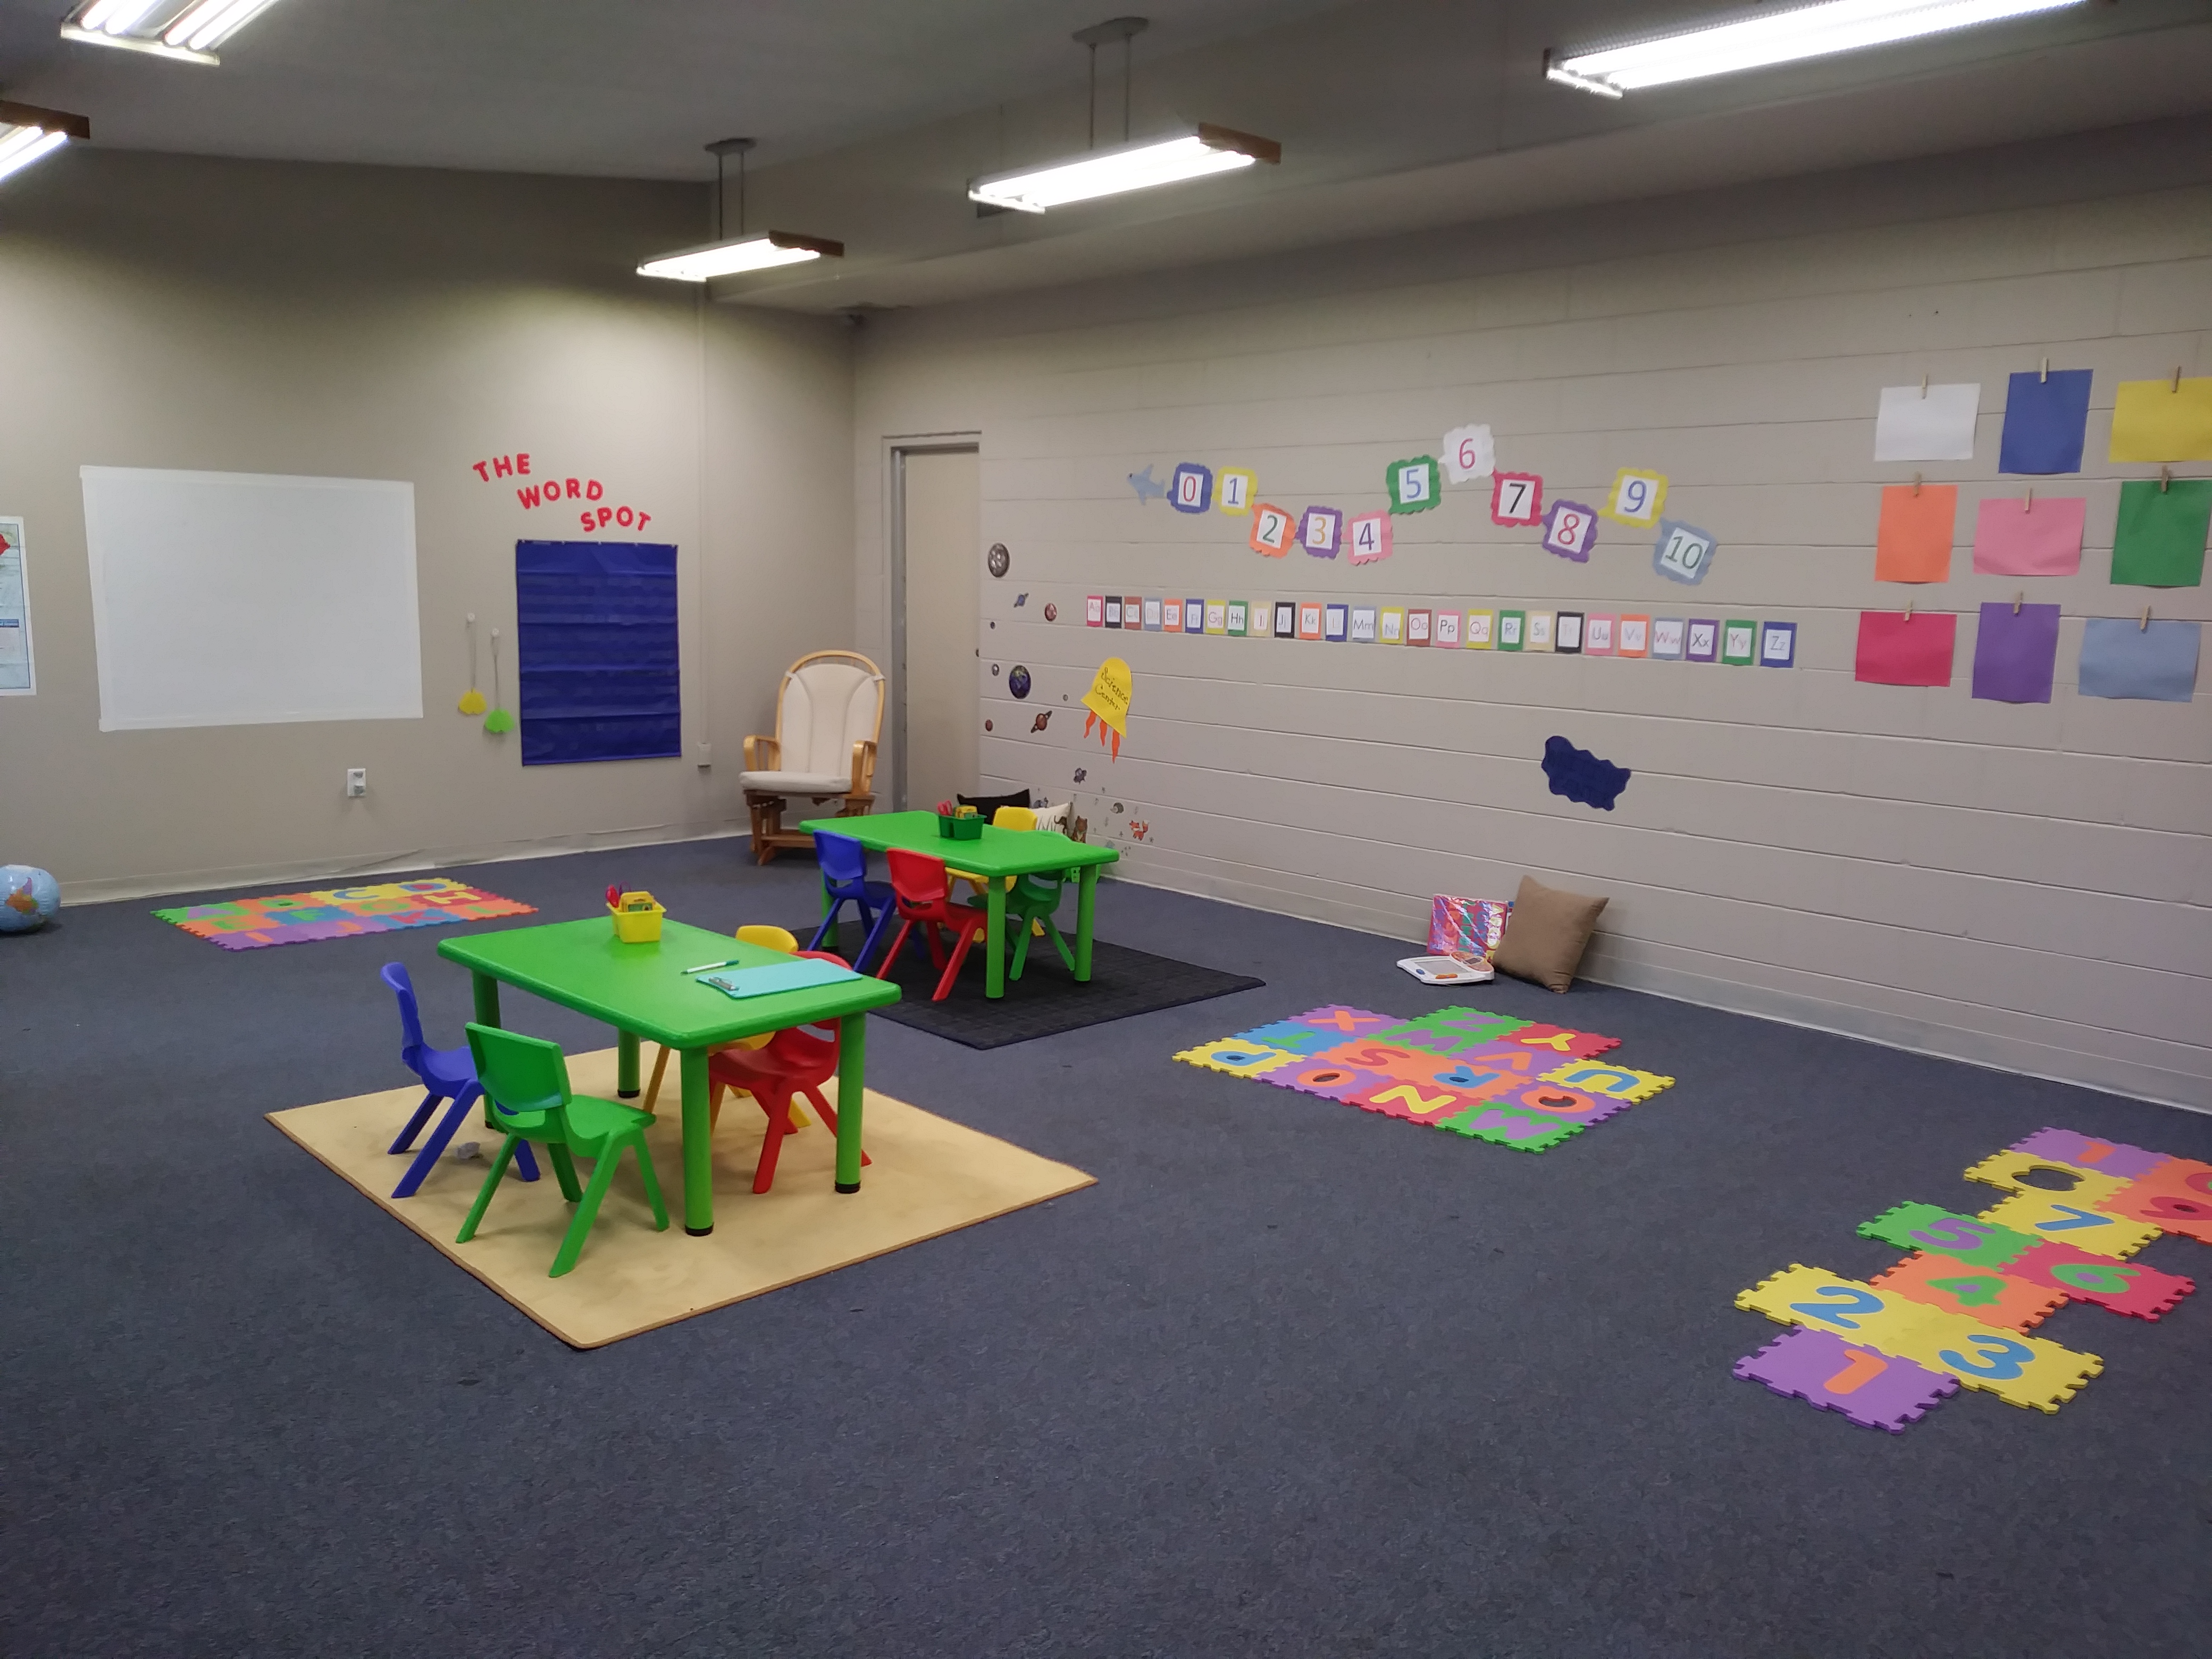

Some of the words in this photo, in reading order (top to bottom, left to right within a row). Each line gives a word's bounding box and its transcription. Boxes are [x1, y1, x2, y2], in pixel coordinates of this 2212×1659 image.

[473, 453, 531, 482] THE
[517, 477, 603, 509] WORD
[1183, 476, 1196, 502] 0
[1228, 477, 1239, 505] 1
[1262, 515, 1278, 544] 2
[1312, 517, 1327, 544] 3
[1359, 523, 1375, 551] 4
[1405, 468, 1422, 499] 5
[1458, 438, 1476, 468] 6
[1509, 482, 1527, 514] 7
[1557, 514, 1580, 546] 8
[1624, 480, 1647, 513] 9
[1665, 535, 1703, 569] 10
[581, 506, 651, 532] SPOT
[1230, 612, 1244, 624] Hh
[1305, 613, 1316, 625] Kk
[1354, 618, 1374, 631] Mm
[1411, 617, 1428, 630] Oo
[1440, 619, 1454, 634] Pp
[1692, 633, 1710, 647] Xx
[1730, 633, 1747, 650] Yy
[1770, 635, 1786, 650] Zz
[1095, 684, 1120, 710] Center
[1101, 667, 1128, 705] Science
[333, 889, 381, 900] C
[398, 883, 447, 892] D
[424, 891, 482, 904] H
[389, 911, 446, 924] K
[1308, 1010, 1381, 1031] X
[1261, 1031, 1316, 1048] T
[1520, 1033, 1576, 1051] Y
[1345, 1048, 1411, 1066] S
[1297, 1068, 1356, 1087] O
[1434, 1066, 1500, 1088] R
[1564, 1069, 1640, 1093] U
[2076, 1141, 2116, 1163] 1
[2035, 1204, 2114, 1231] 7
[2140, 1196, 2212, 1220] 9
[1910, 1218, 1996, 1250] 5
[2051, 1264, 2141, 1294] 6
[1925, 1275, 2008, 1307] 4
[1790, 1286, 1886, 1329] 2
[1939, 1335, 2035, 1380] 3
[1824, 1349, 1888, 1395] 1
